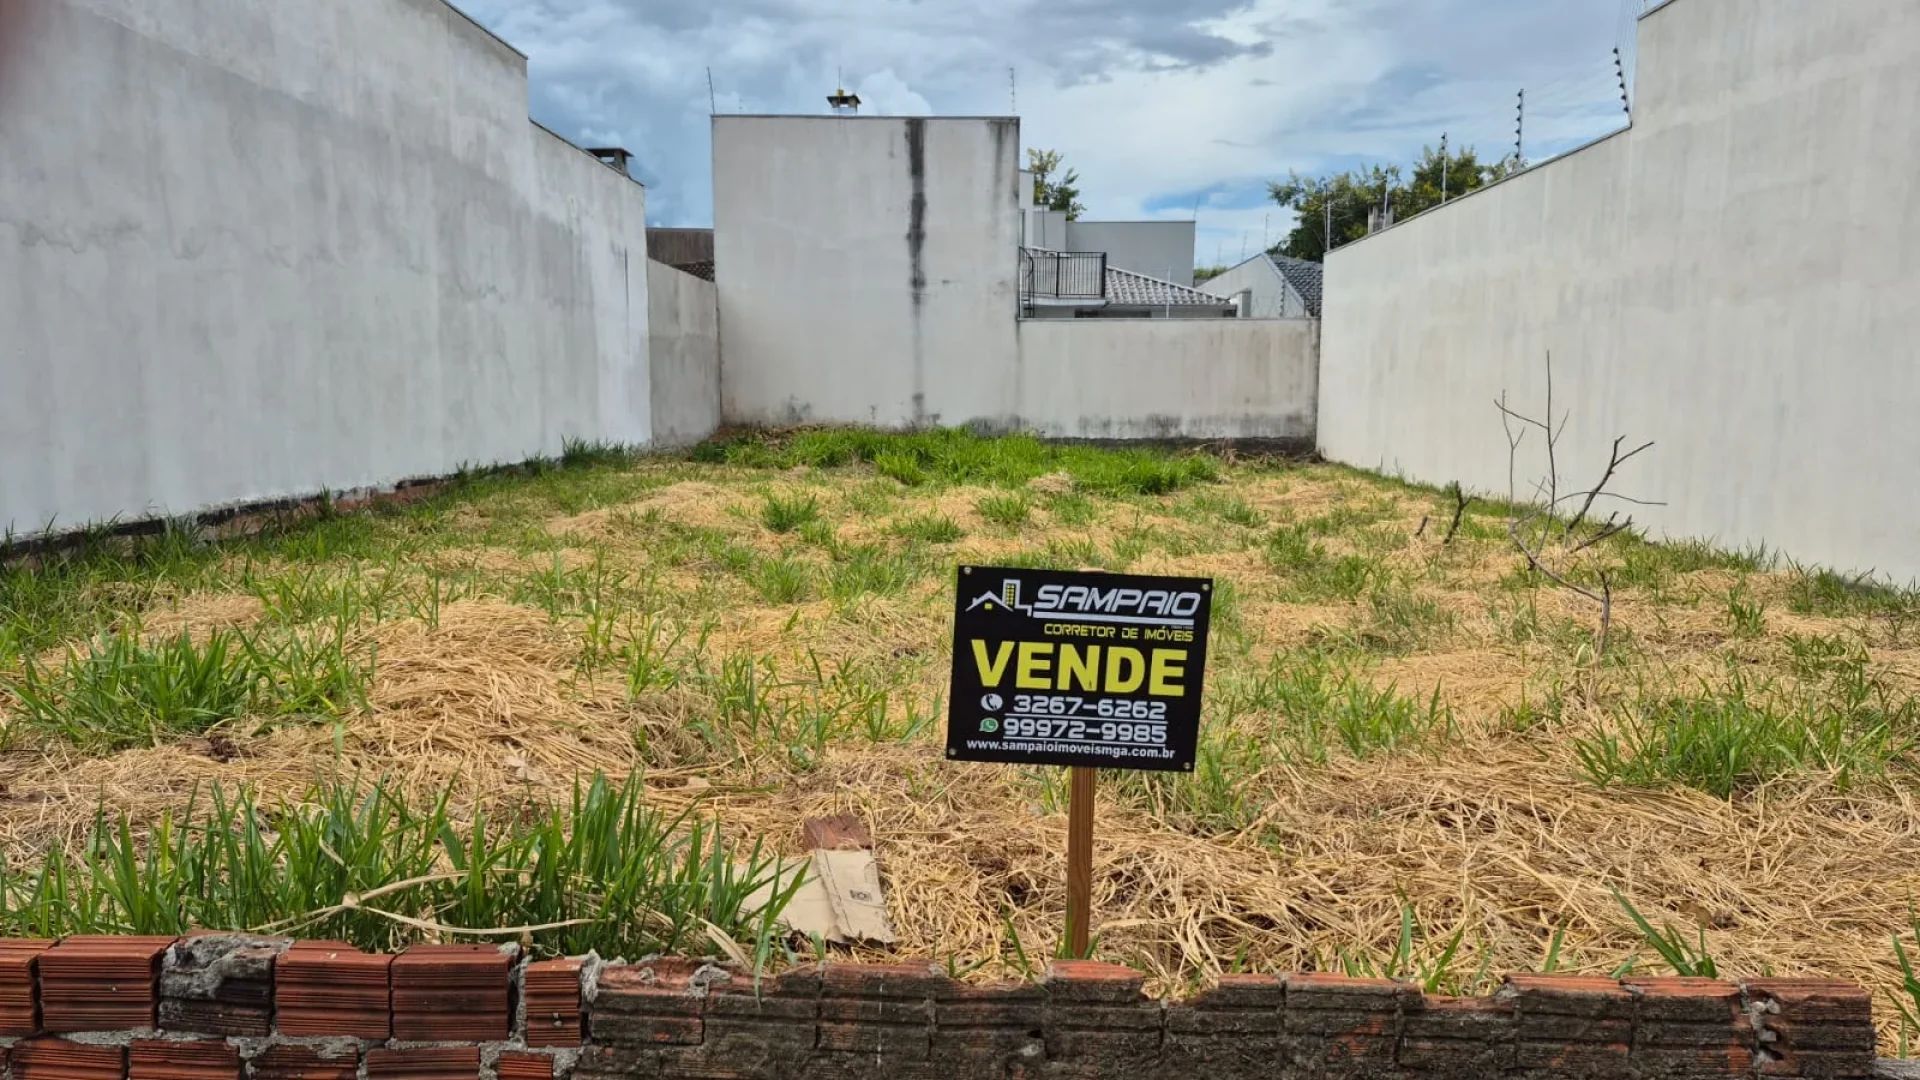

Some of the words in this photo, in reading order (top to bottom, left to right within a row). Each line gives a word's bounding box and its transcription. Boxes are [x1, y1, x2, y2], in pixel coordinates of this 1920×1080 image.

[1037, 585, 1201, 616] SAMPAIO
[1044, 623, 1116, 640] CORRETOR
[1122, 629, 1139, 640] DE
[1144, 626, 1194, 642] IMÓVEIS
[971, 639, 1188, 697] VENDE
[1013, 695, 1167, 720] 3267-6262
[1003, 719, 1167, 743] 99972-9985
[966, 739, 1176, 759] www.sampaioimoveismga.com.br
